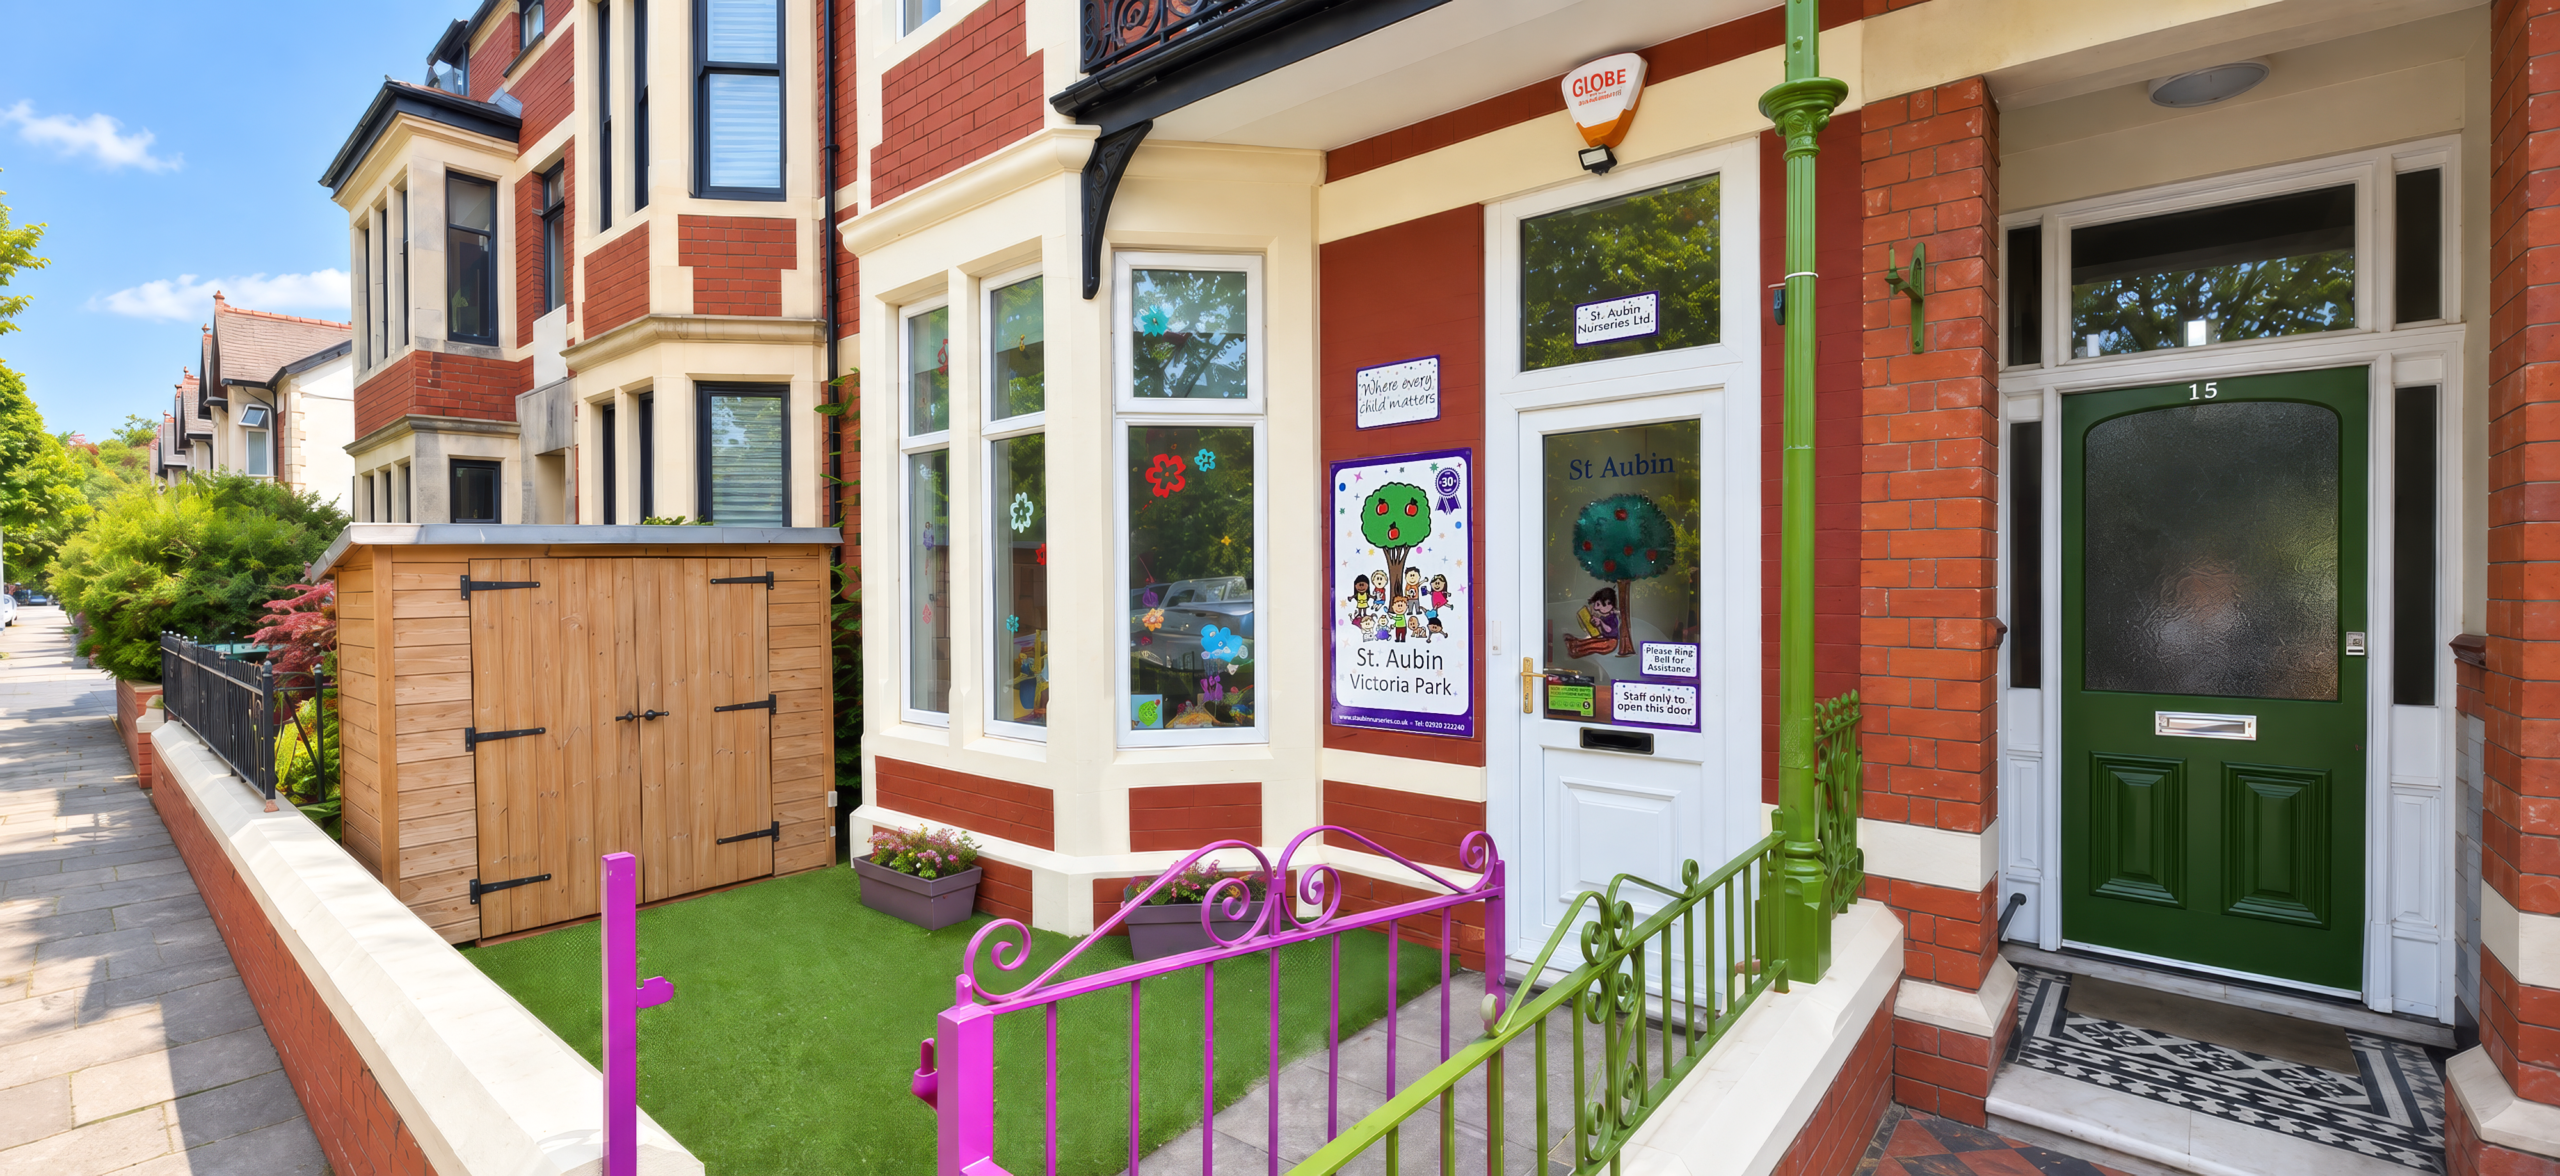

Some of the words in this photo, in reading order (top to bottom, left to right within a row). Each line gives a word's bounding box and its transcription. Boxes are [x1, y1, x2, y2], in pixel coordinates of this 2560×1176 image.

[1572, 69, 1626, 97] GLOBE
[1590, 310, 1604, 322] St.
[1607, 305, 1641, 318] Aubin
[1578, 318, 1630, 335] Nurseries
[1633, 312, 1654, 326] Ltd.
[1402, 375, 1432, 392] every
[2188, 382, 2218, 401] 15
[1359, 396, 1386, 414] child
[1389, 393, 1436, 409] matters
[1569, 459, 1593, 480] St
[1599, 452, 1676, 478] Aubin
[1441, 476, 1454, 488] 30
[1356, 647, 1379, 668] St.
[1385, 648, 1443, 671] Aubin
[1645, 646, 1673, 655] Please
[1674, 647, 1694, 658] Ring
[1654, 655, 1670, 663] Bell
[1672, 656, 1684, 664] for
[1647, 663, 1691, 673] Assistance
[1349, 673, 1409, 693] Victoria
[1415, 677, 1452, 696] Park
[1623, 691, 1647, 702] Staff
[1649, 693, 1672, 705] only
[1674, 695, 1686, 704] to
[1617, 703, 1643, 712] open
[1645, 703, 1664, 713] this
[1667, 704, 1692, 715] door
[1425, 721, 1442, 729] 02920
[1443, 722, 1465, 731] 222240
